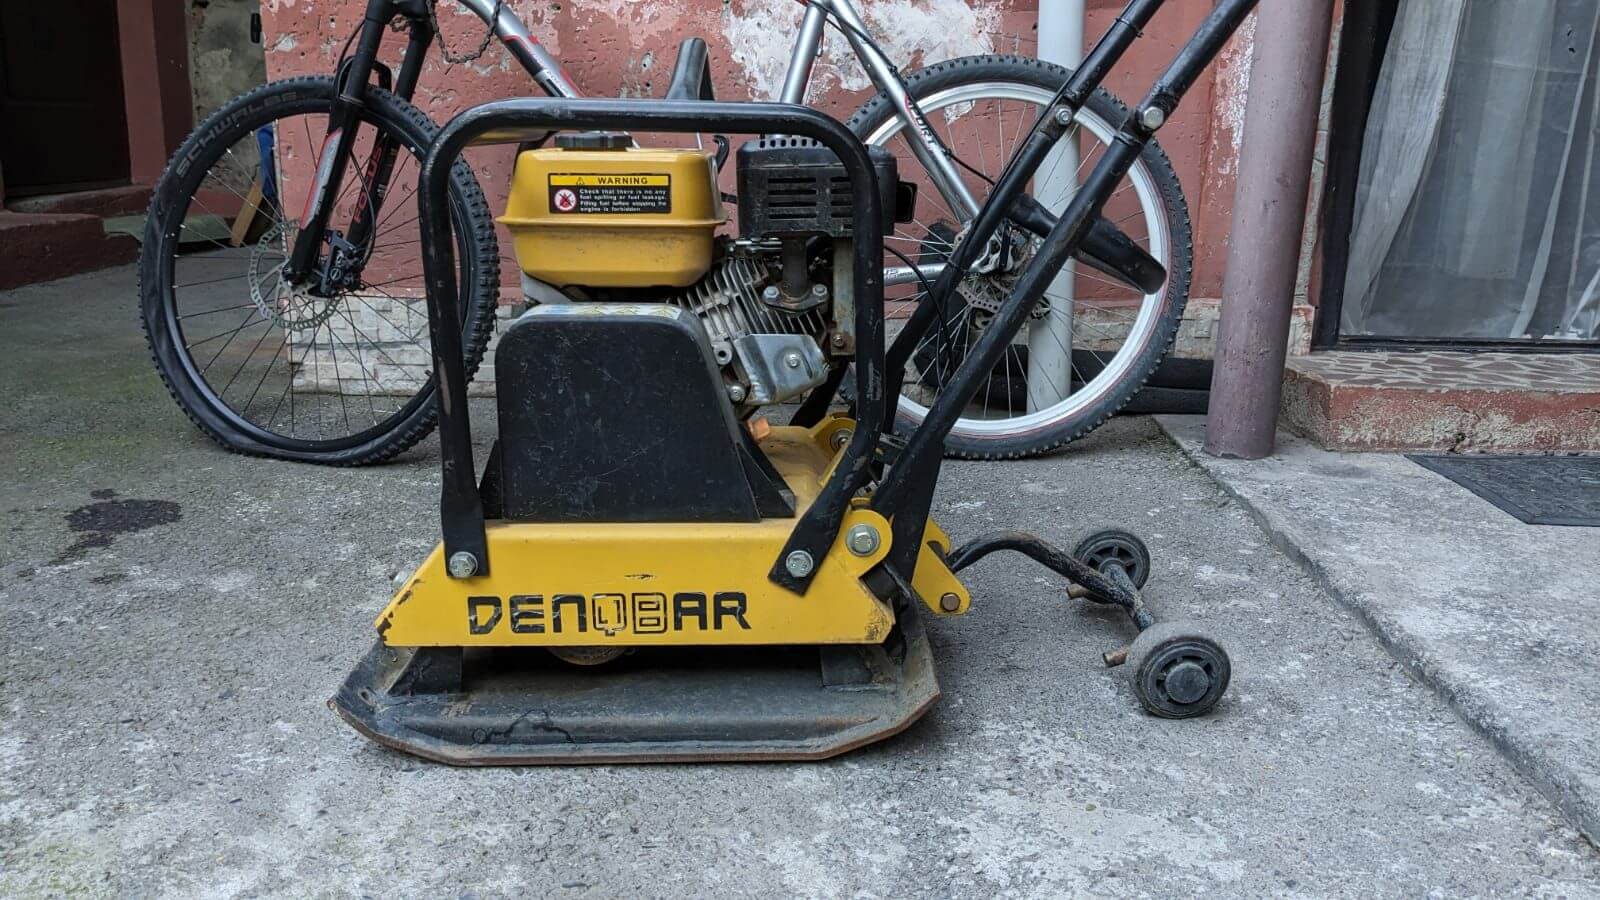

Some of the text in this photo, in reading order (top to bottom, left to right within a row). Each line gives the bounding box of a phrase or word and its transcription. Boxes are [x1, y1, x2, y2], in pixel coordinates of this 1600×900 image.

[175, 91, 297, 178] SCHWALBE
[597, 176, 649, 185] WARNING
[467, 591, 752, 636] DENQBAR
